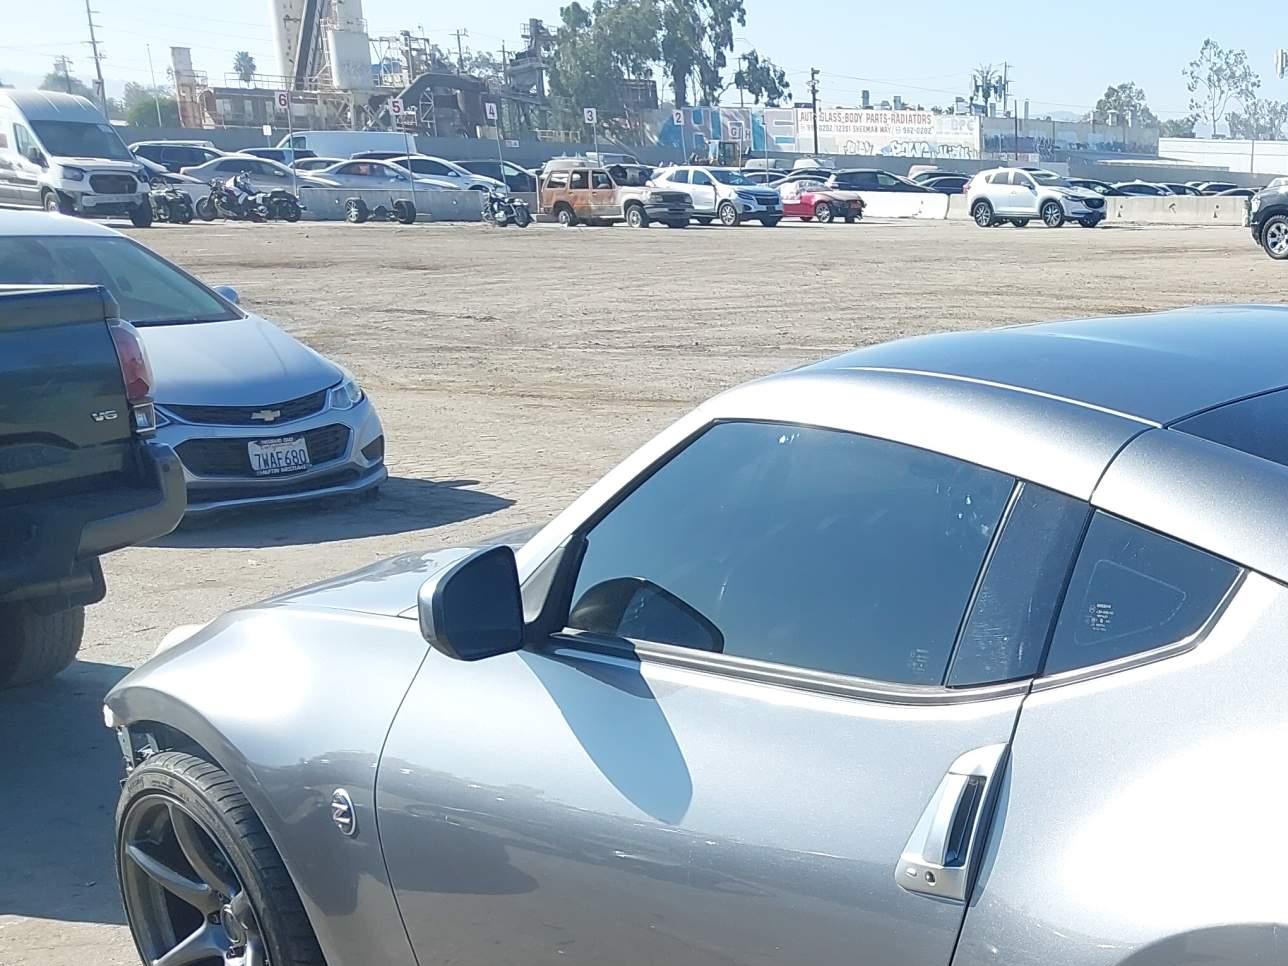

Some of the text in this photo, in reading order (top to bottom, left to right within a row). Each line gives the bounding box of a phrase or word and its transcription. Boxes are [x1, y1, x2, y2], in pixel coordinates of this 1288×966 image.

[279, 93, 288, 107] 6
[392, 100, 401, 114] 5
[488, 103, 496, 115] 4
[585, 110, 594, 121] 3
[675, 112, 682, 123] 2
[730, 128, 737, 137] G
[745, 130, 751, 139] H
[92, 409, 118, 422] V6
[254, 448, 307, 469] 7WAF680
